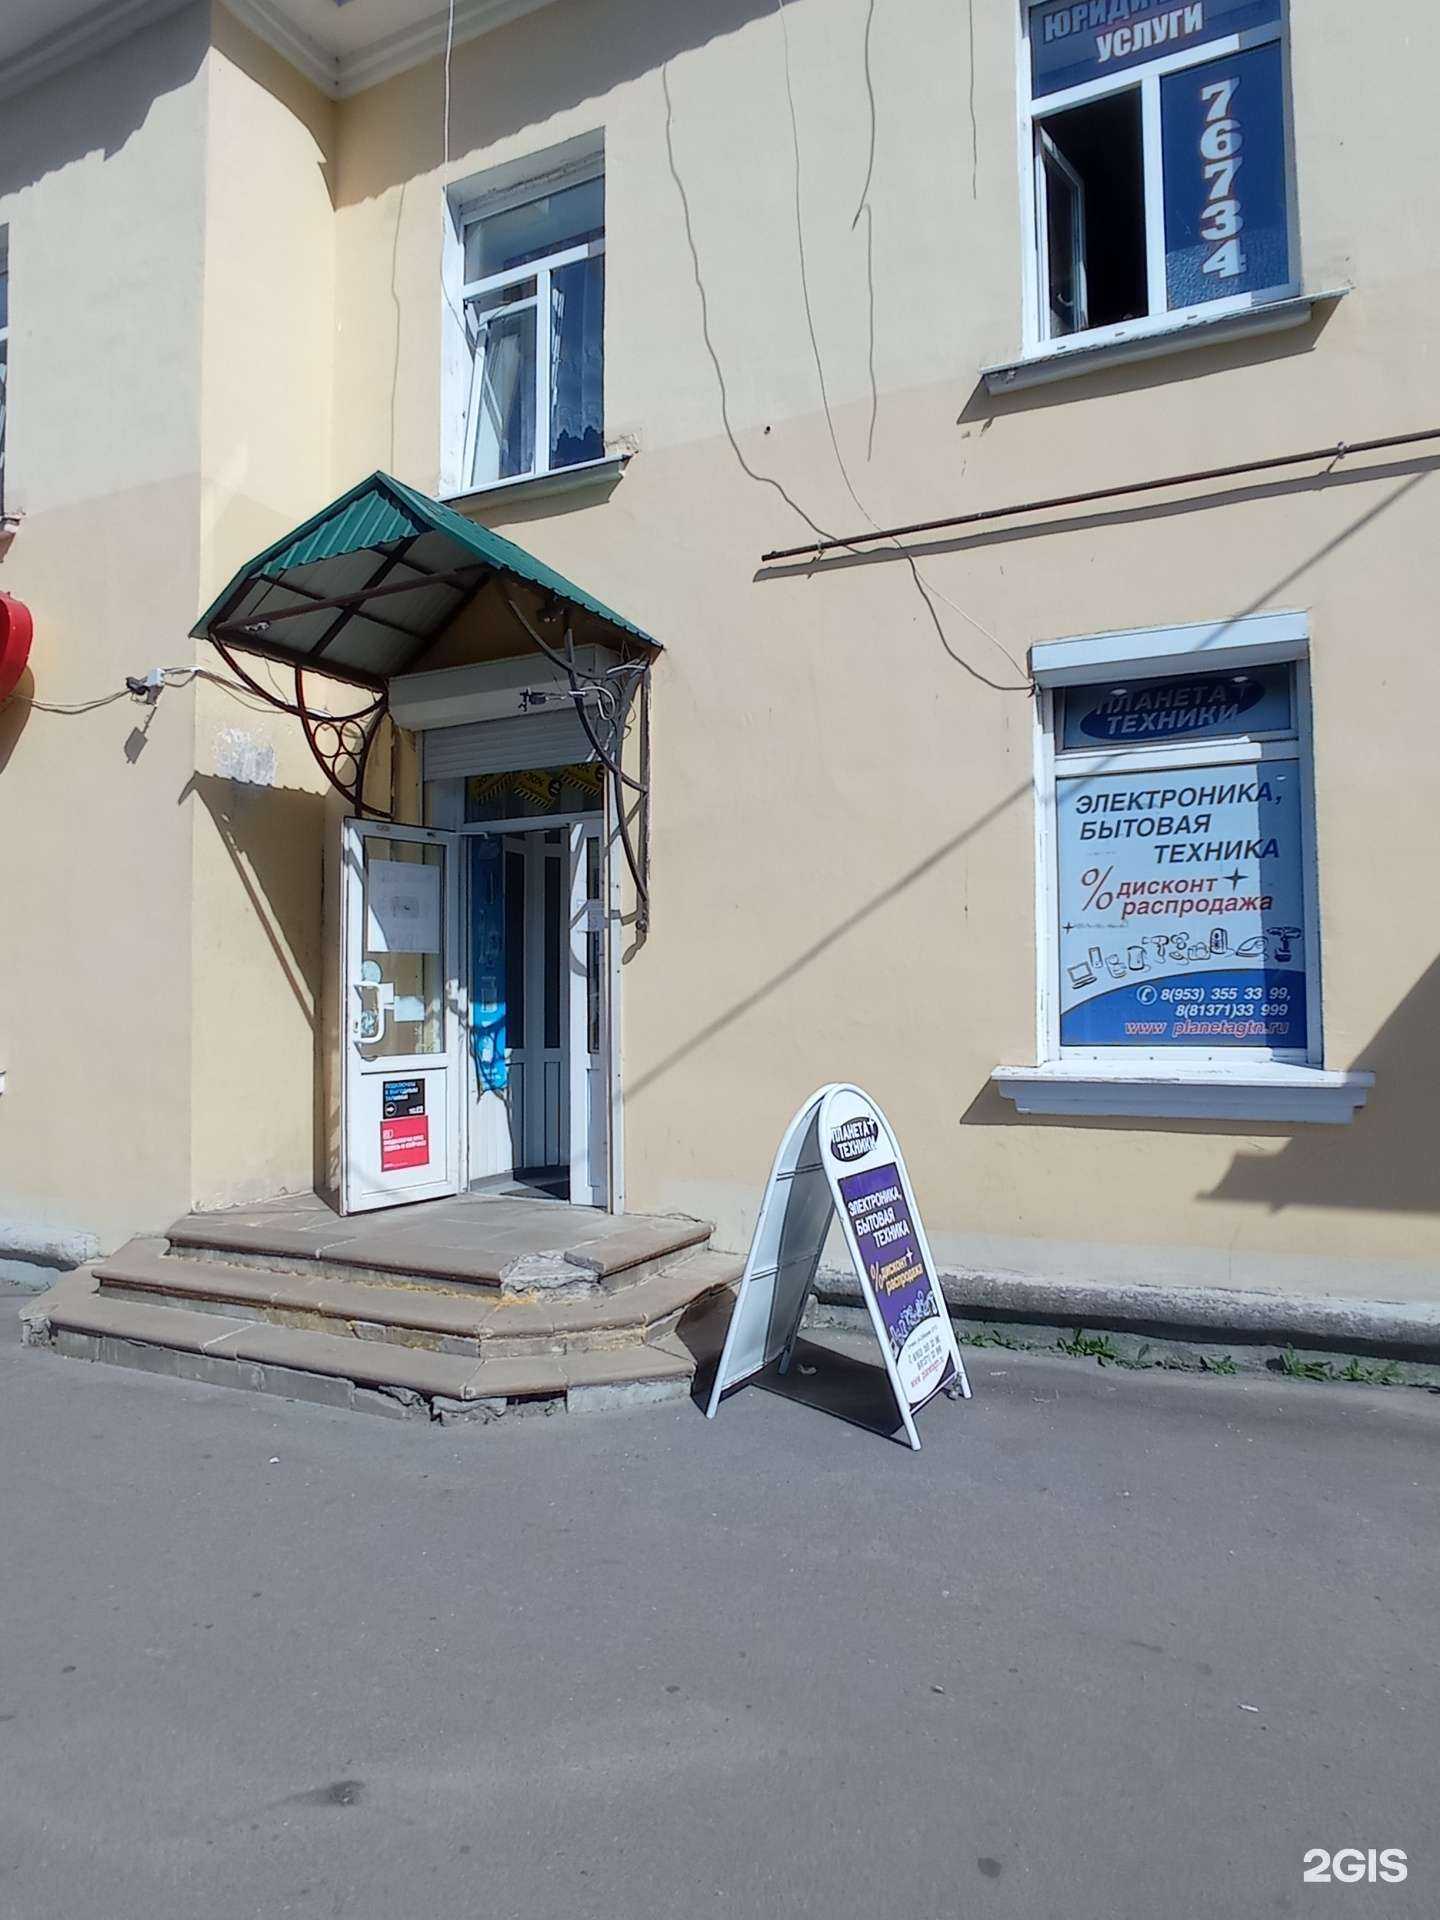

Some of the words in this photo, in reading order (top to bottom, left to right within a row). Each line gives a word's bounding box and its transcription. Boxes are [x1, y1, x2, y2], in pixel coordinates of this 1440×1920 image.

[1096, 2, 1203, 63] УСЛУГИ
[1200, 77, 1247, 279] 76734
[1097, 684, 1226, 715] ПЛАНЕТА
[1107, 704, 1239, 736] ТЕХНИКИ
[1076, 782, 1282, 815] ЭЛЕКТРОНИКА,
[1080, 814, 1212, 841] БЫТОВАЯ
[1154, 839, 1280, 864] ТЕХНИКА
[1116, 878, 1218, 900] дисконт
[1121, 894, 1273, 920] распродажа
[1160, 987, 1205, 1002] 8(953)
[1211, 987, 1238, 1000] 355
[1244, 987, 1263, 1000] 33
[1260, 1003, 1289, 1017] 999
[855, 1207, 896, 1237] БЫТОВАЯ
[873, 1219, 911, 1248] ТЕХНИКА
